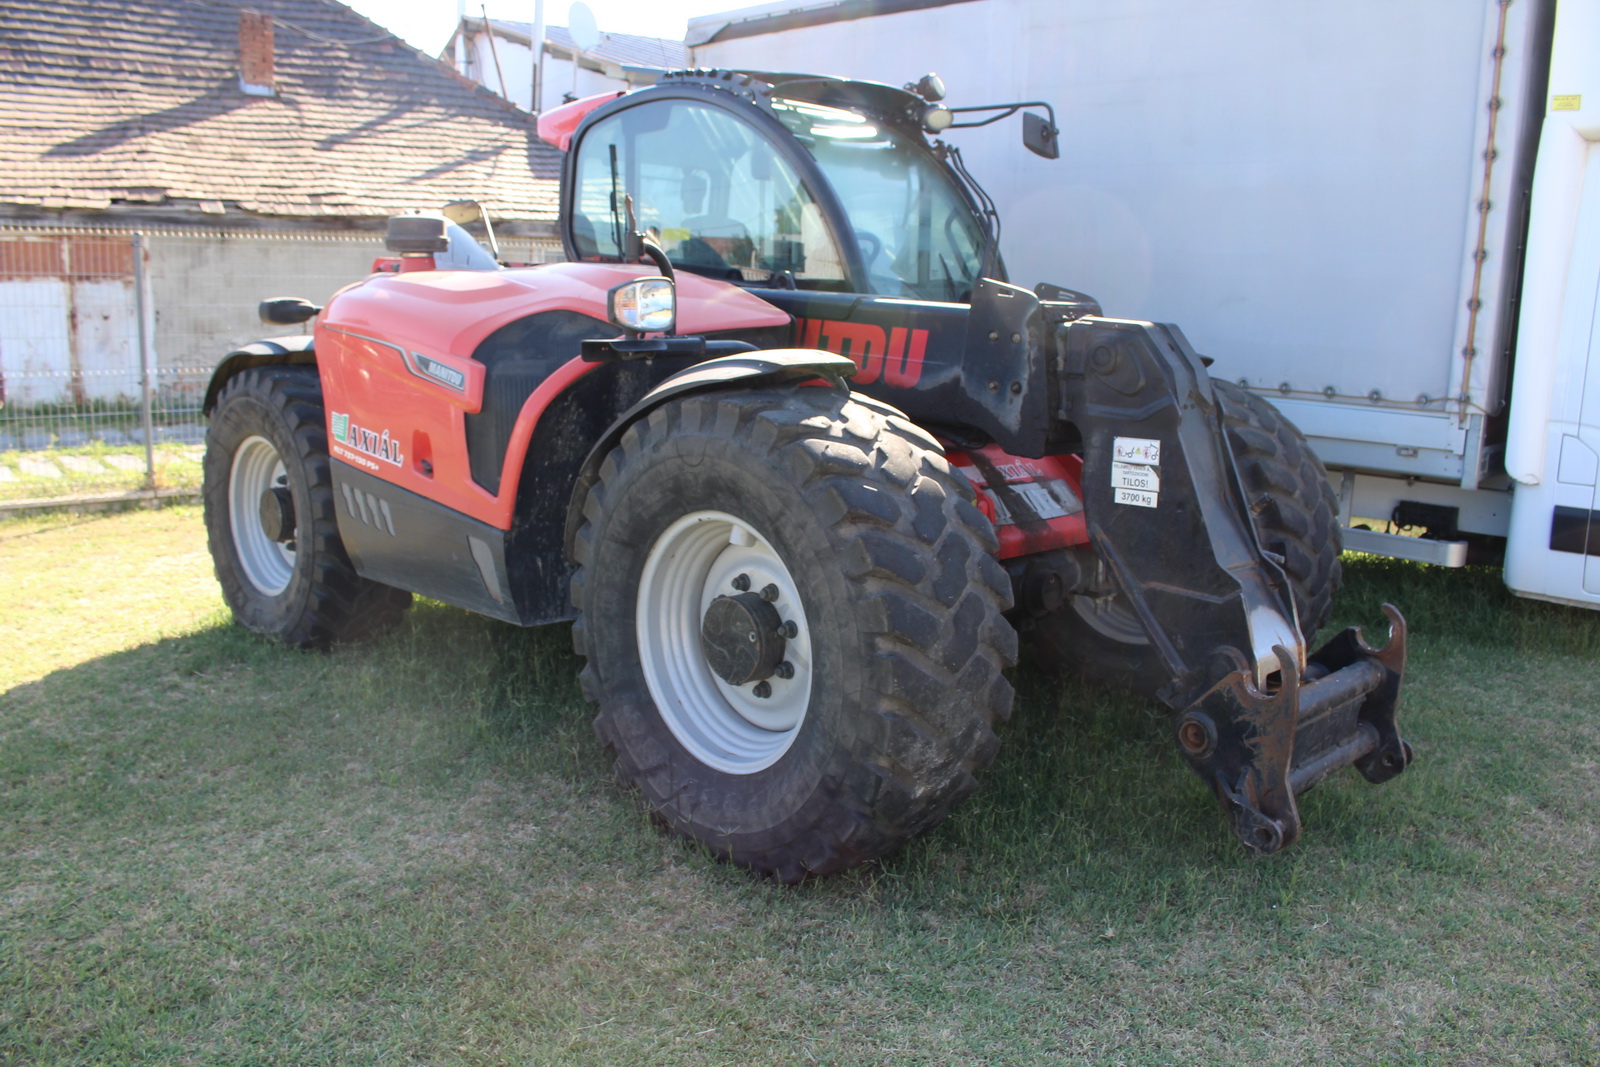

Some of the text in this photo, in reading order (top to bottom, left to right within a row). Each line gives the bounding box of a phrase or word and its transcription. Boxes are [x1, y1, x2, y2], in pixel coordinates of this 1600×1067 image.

[428, 361, 463, 386] MANITOU
[349, 425, 404, 466] AXIÁL
[995, 459, 1044, 480] XIÁL
[1122, 477, 1149, 488] TILOS!
[1121, 492, 1152, 506] 3700 kg
